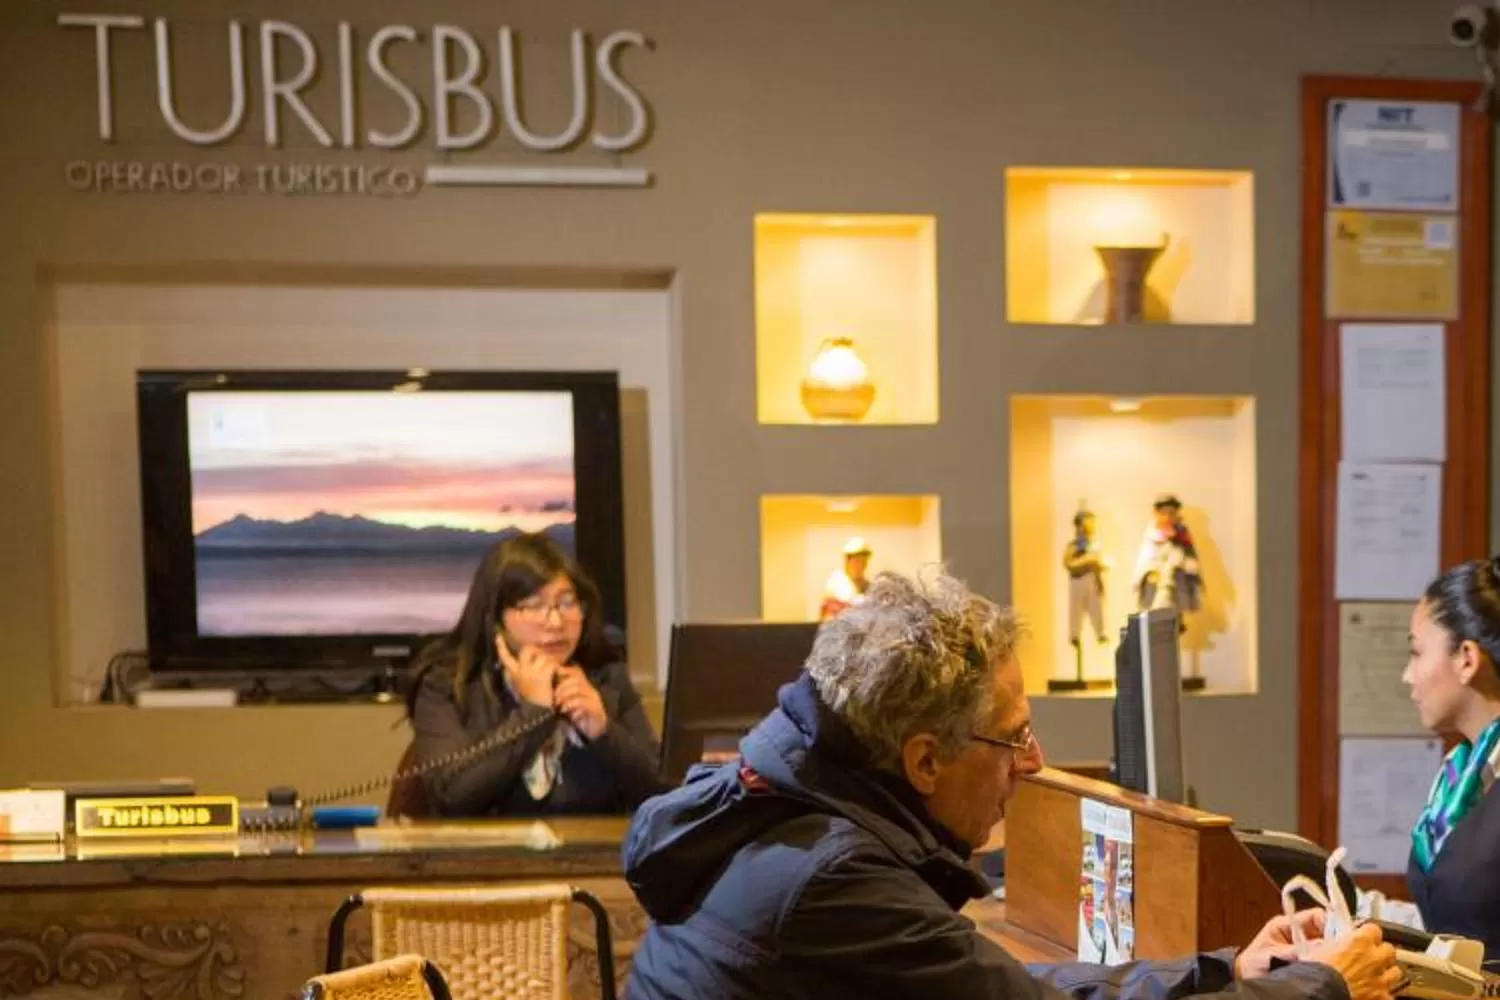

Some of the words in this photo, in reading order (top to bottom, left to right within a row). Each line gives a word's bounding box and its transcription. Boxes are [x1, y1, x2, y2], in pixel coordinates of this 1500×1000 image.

[57, 13, 652, 151] TURISBUS
[65, 159, 242, 192] OPERADOR
[97, 804, 212, 827] Turisbus
